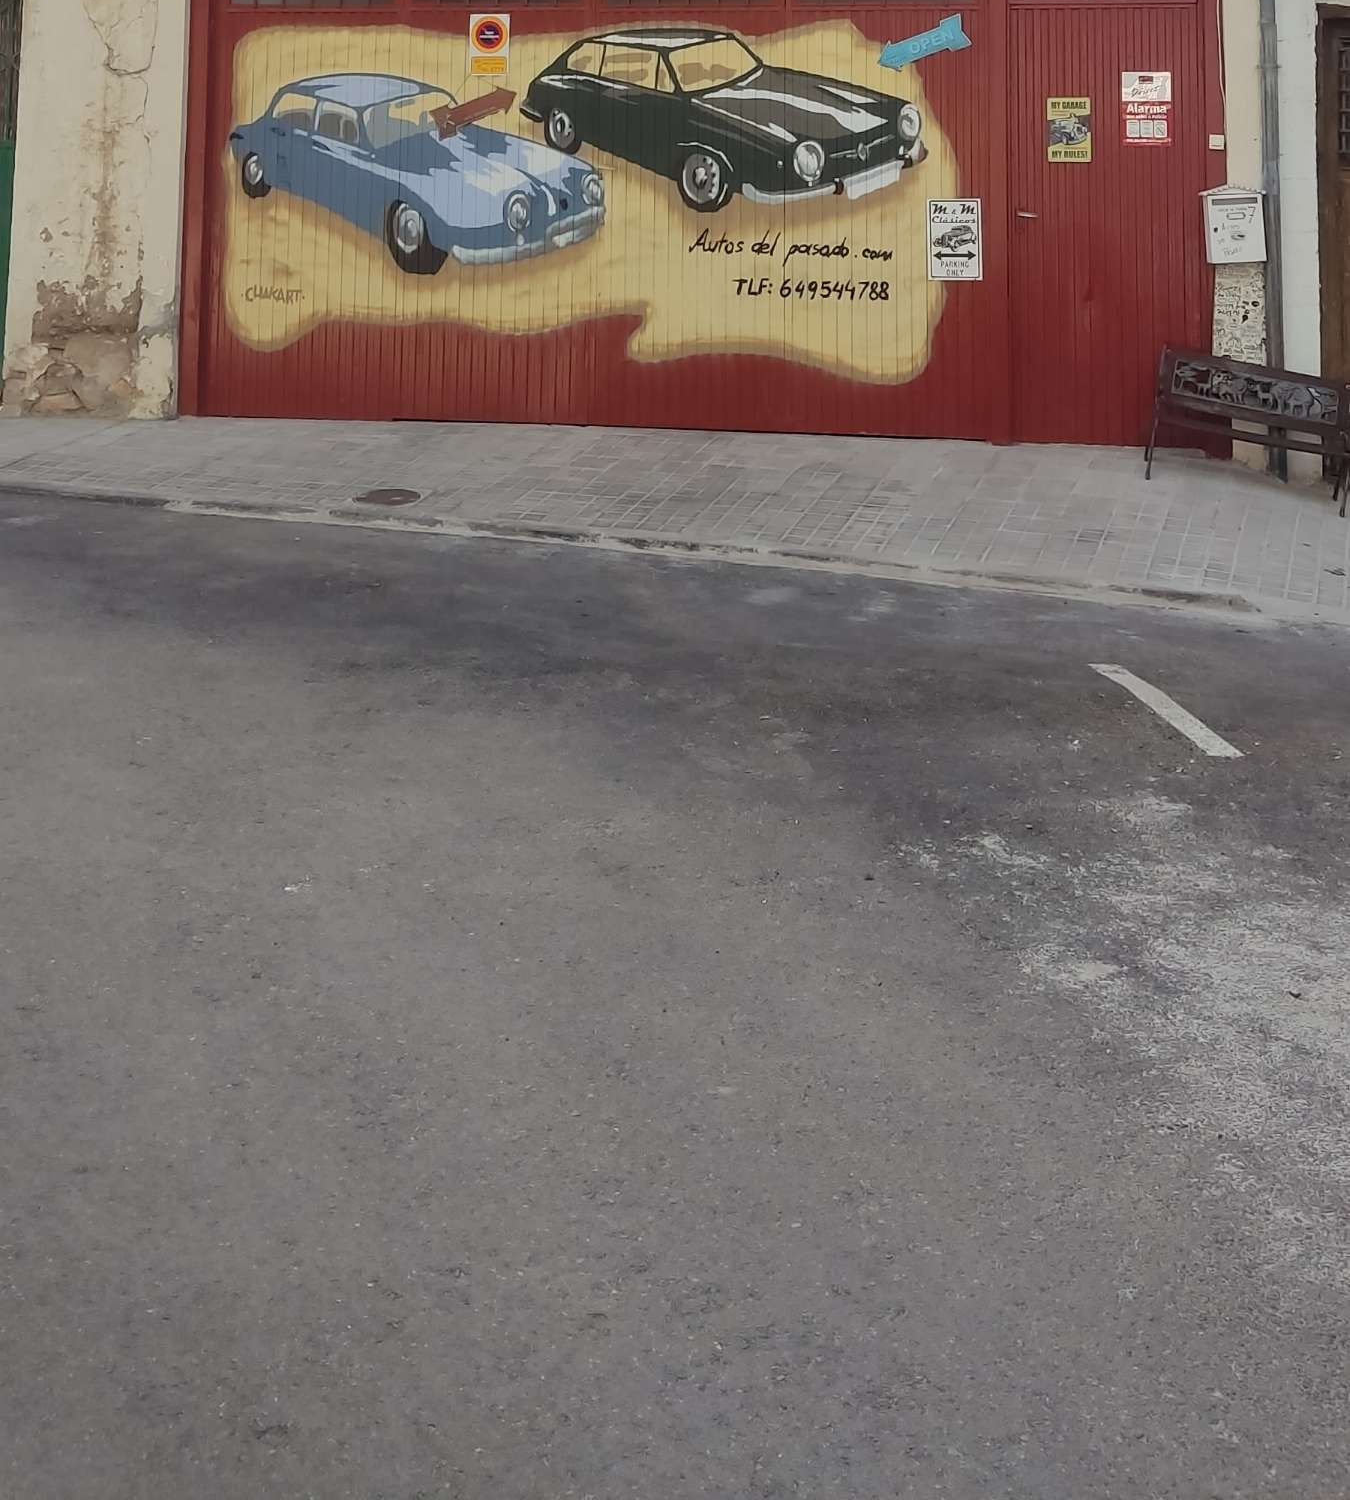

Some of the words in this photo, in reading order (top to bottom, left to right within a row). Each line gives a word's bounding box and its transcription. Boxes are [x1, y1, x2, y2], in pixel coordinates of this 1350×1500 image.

[910, 28, 955, 54] OPEN
[1062, 101, 1088, 110] GARAGE
[1126, 102, 1168, 114] Alarma
[1051, 150, 1062, 159] MY
[1247, 205, 1256, 224] 7
[688, 227, 745, 254] Autos
[751, 228, 782, 257] del
[782, 236, 850, 267] pasado
[940, 260, 970, 269] PARKING
[946, 268, 965, 278] ONLY
[732, 277, 773, 296] TLF:
[779, 278, 890, 301] 649544788
